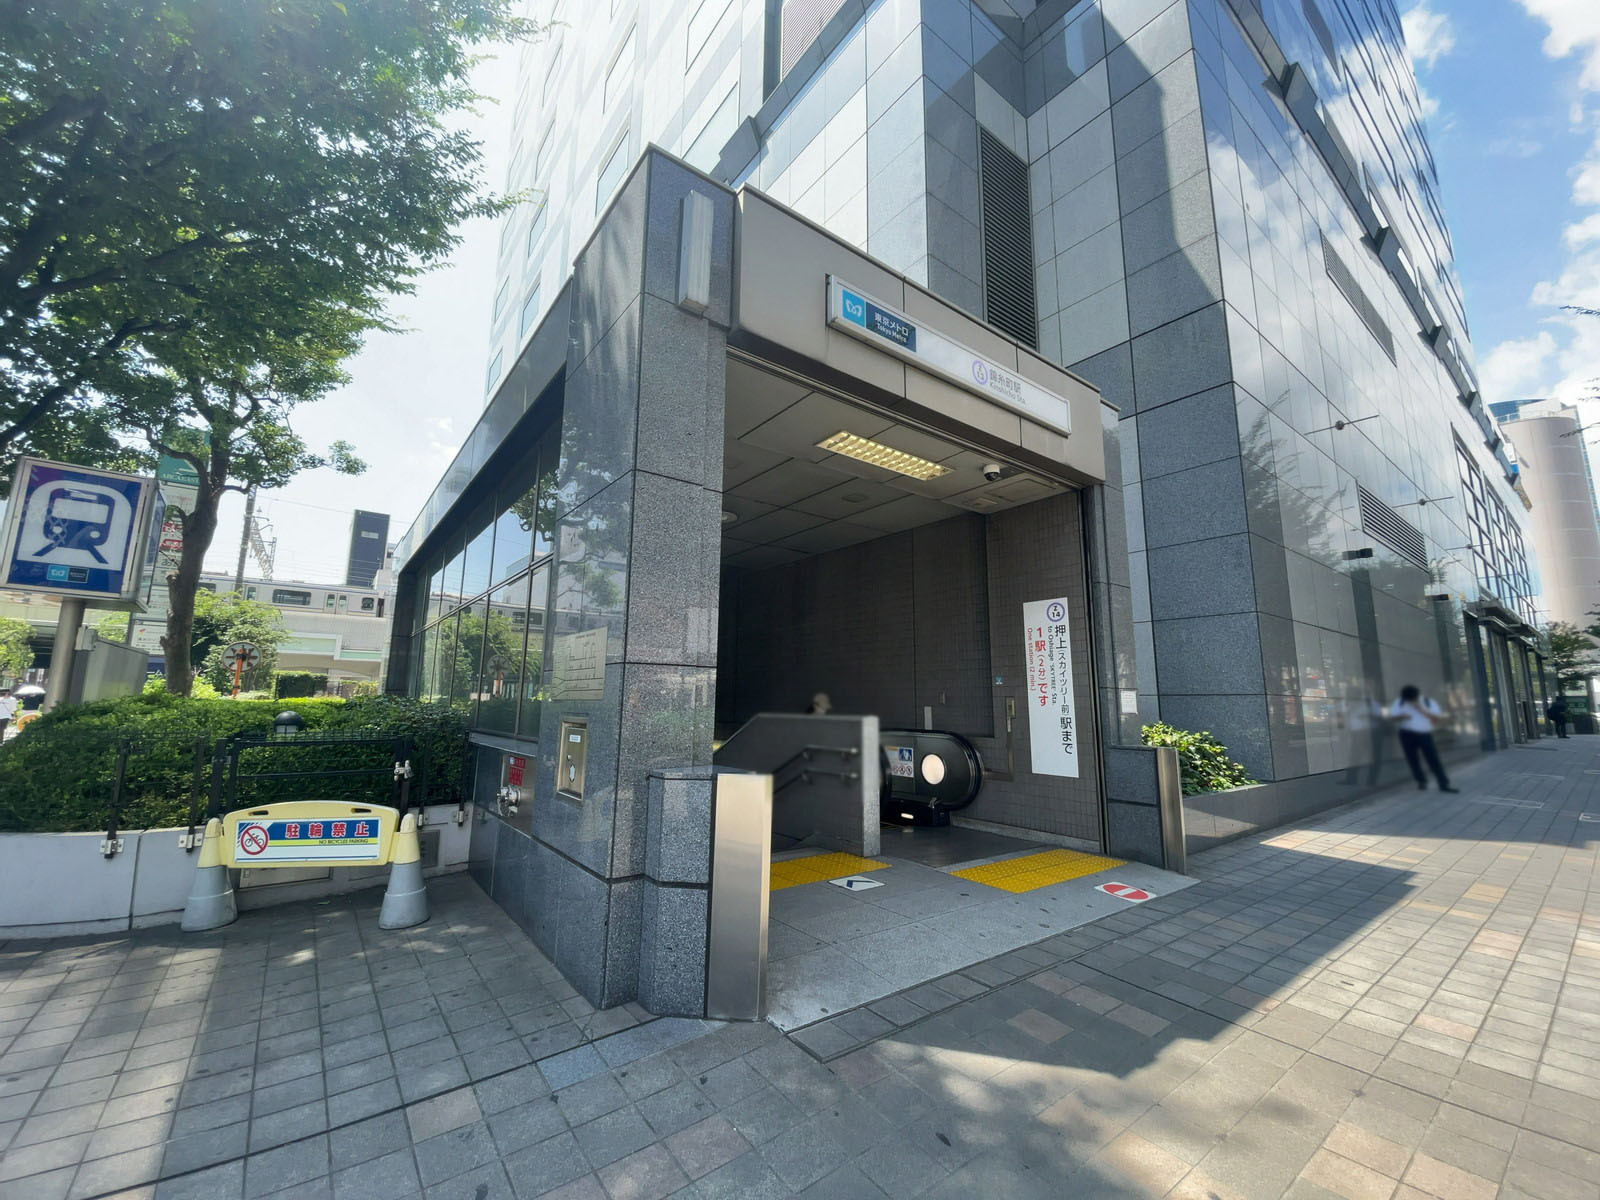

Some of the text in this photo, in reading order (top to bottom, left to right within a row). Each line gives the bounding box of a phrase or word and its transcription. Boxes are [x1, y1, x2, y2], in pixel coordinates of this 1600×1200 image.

[875, 312, 909, 337] 東京メトロ
[877, 323, 907, 343] Tokyo Metro
[990, 369, 1021, 394] 錦糸町駅
[285, 822, 369, 838] 駐輪禁止
